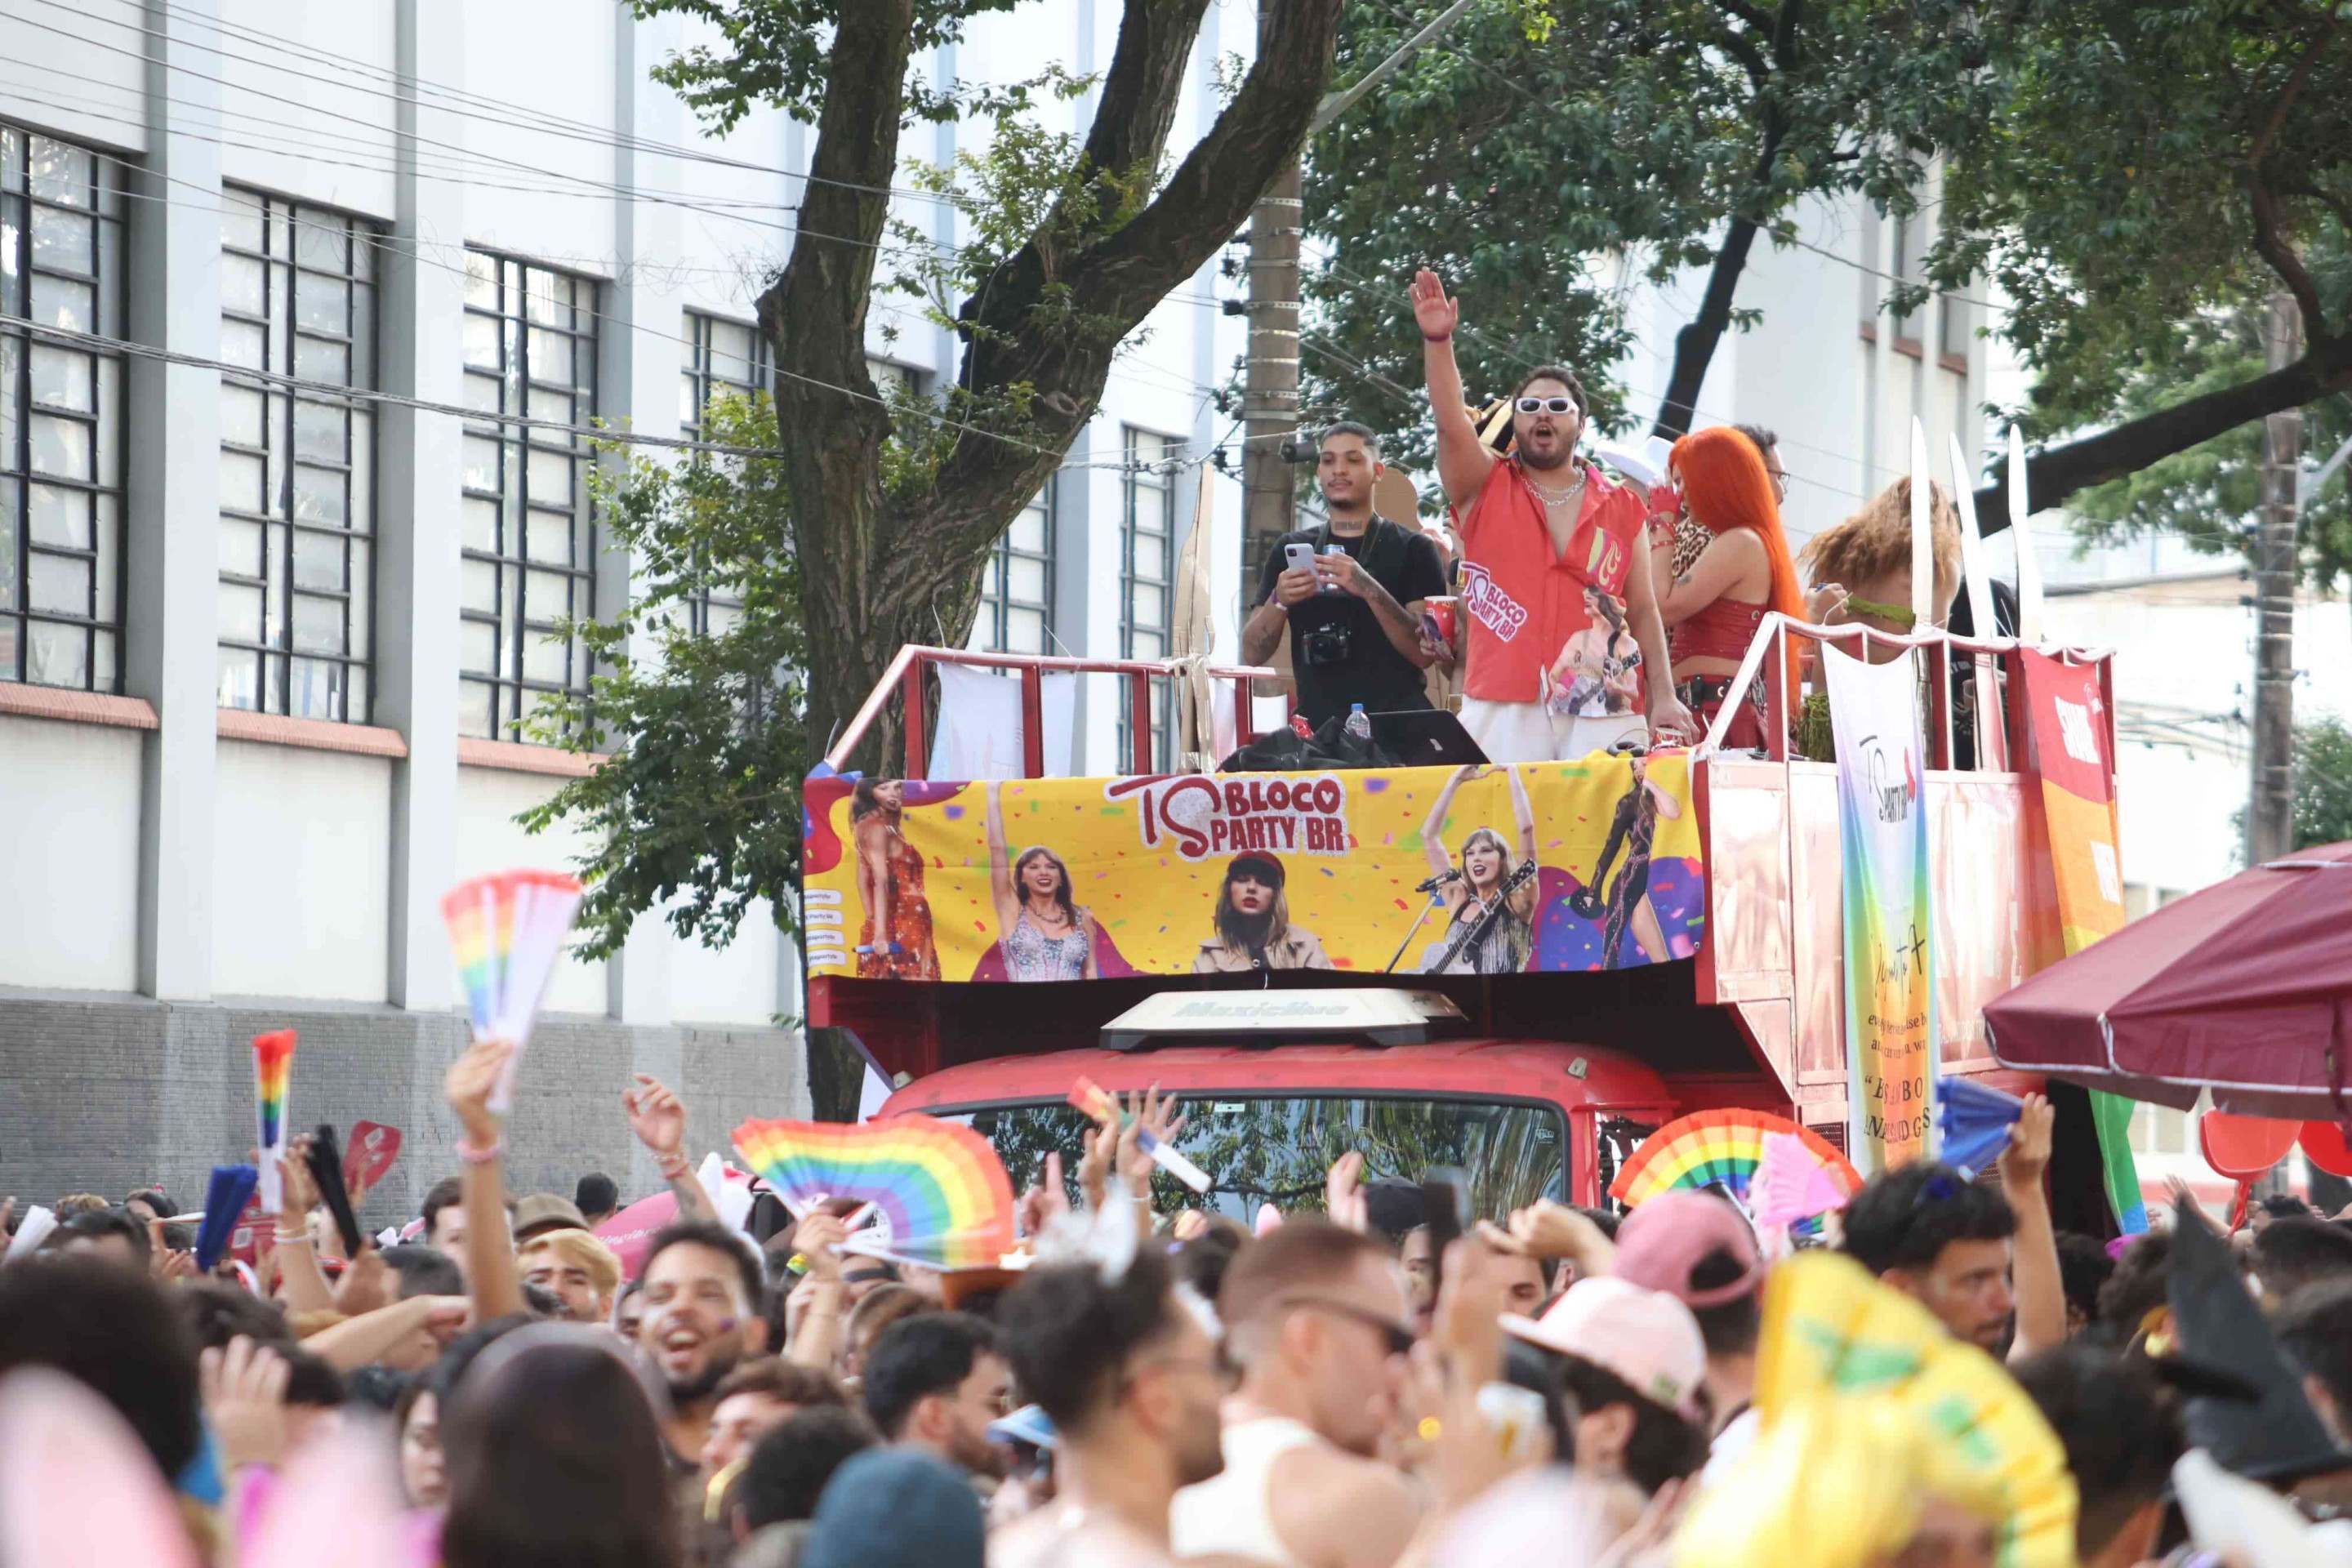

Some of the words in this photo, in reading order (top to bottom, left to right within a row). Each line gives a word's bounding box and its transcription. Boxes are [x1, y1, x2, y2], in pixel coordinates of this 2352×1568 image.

[1486, 585, 1525, 625] BLOCO
[1499, 620, 1516, 640] BR
[1226, 779, 1341, 817] BLOCO
[1210, 816, 1296, 852] PARTY
[1307, 817, 1344, 851] BR
